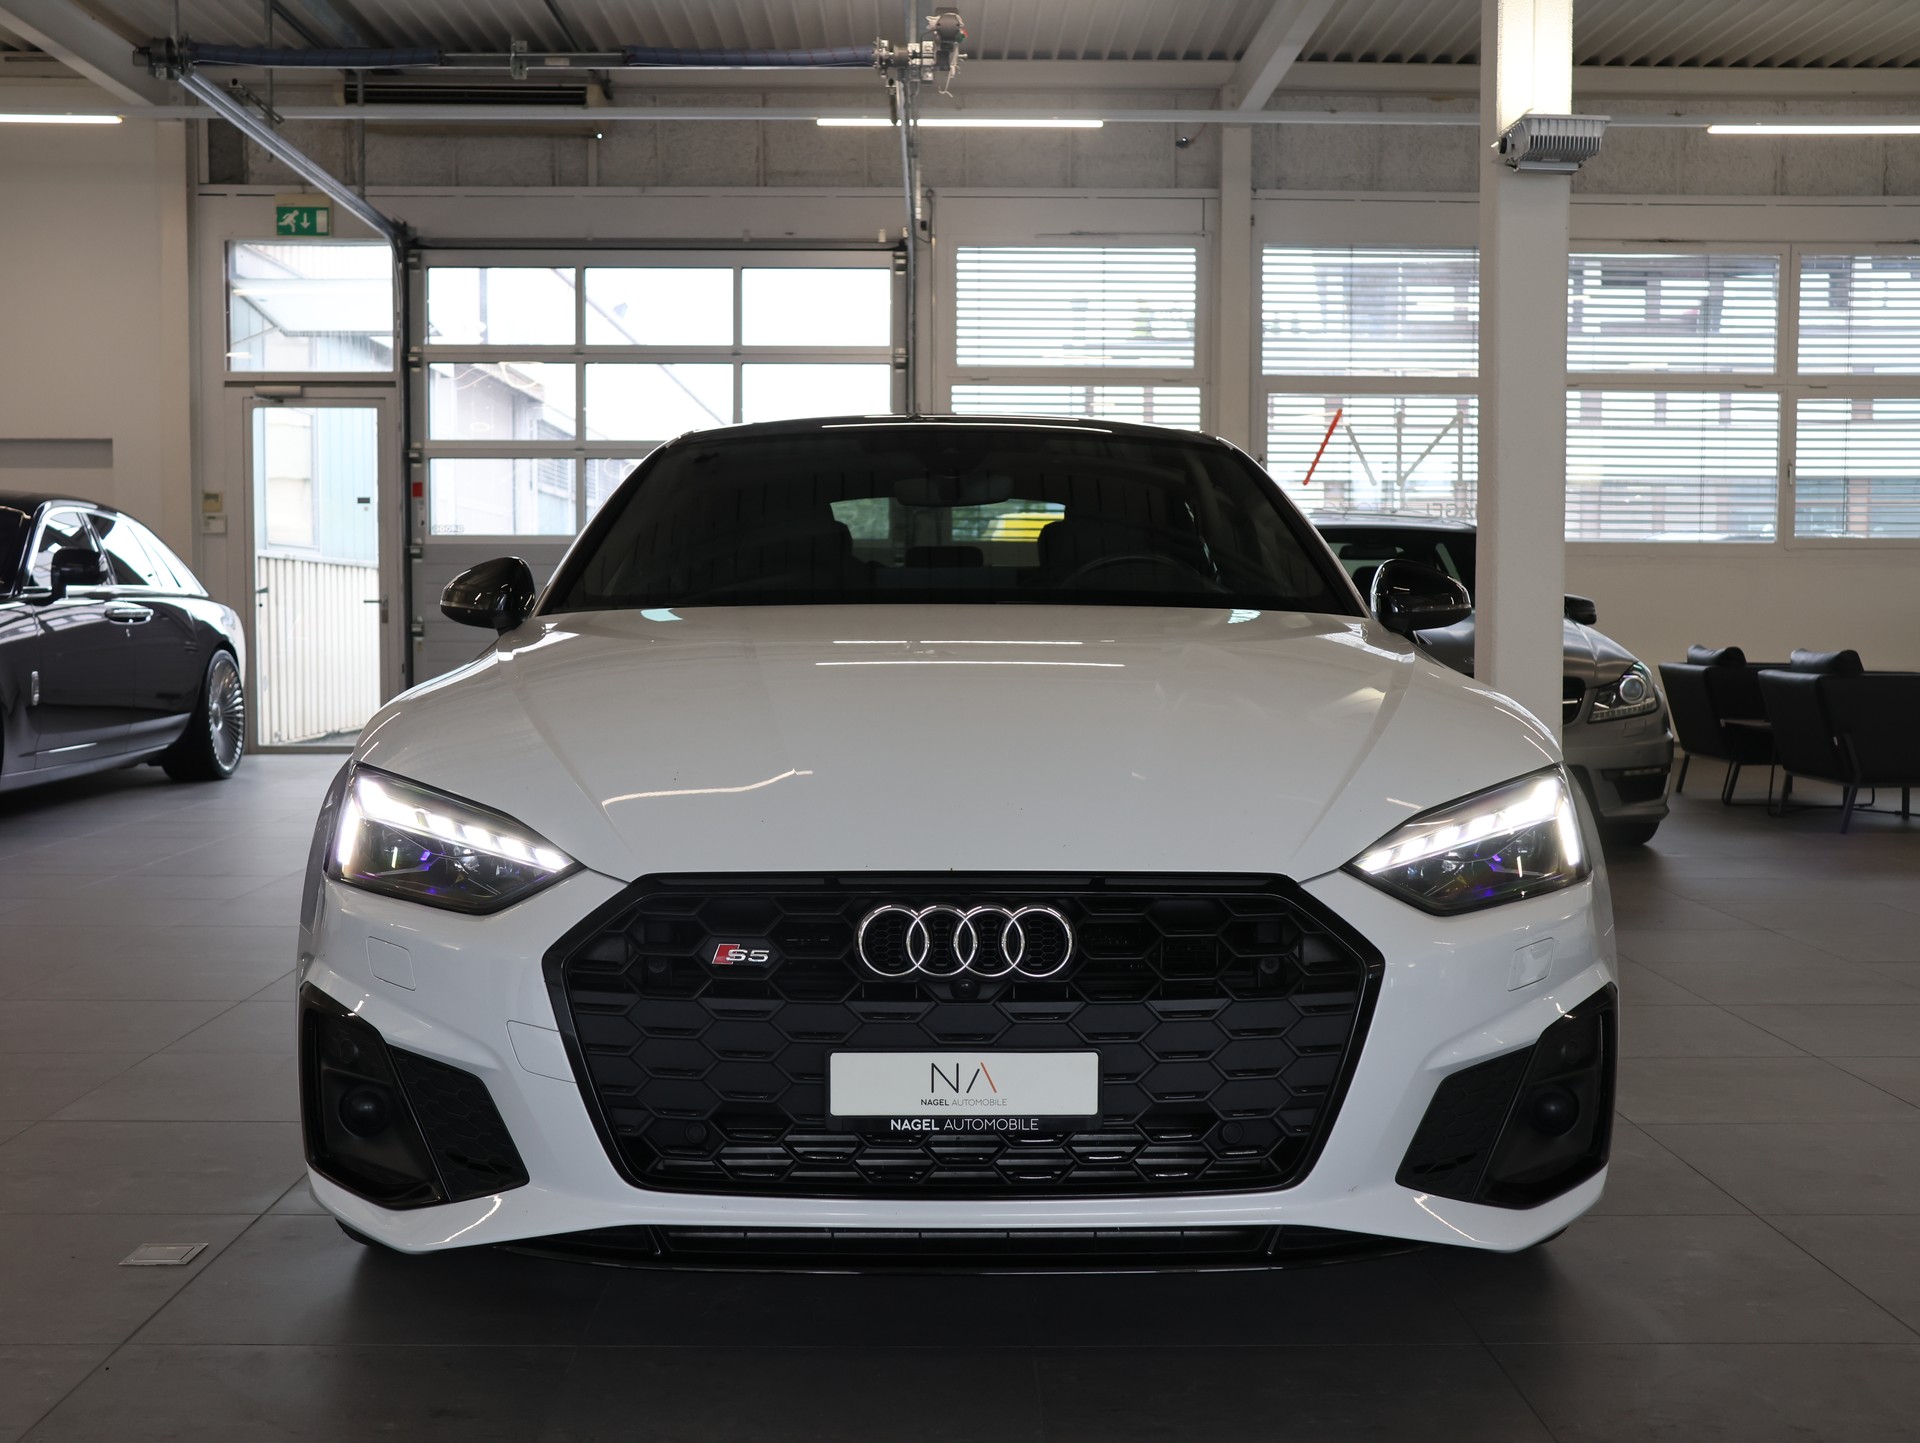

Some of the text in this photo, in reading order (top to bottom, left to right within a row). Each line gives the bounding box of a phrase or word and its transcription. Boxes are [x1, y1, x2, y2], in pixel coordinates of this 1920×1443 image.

[726, 949, 770, 963] S5
[920, 1098, 1008, 1107] NAGEL AUTOMOBILE
[890, 1118, 1039, 1131] NAGEL AUTOMOBILE
